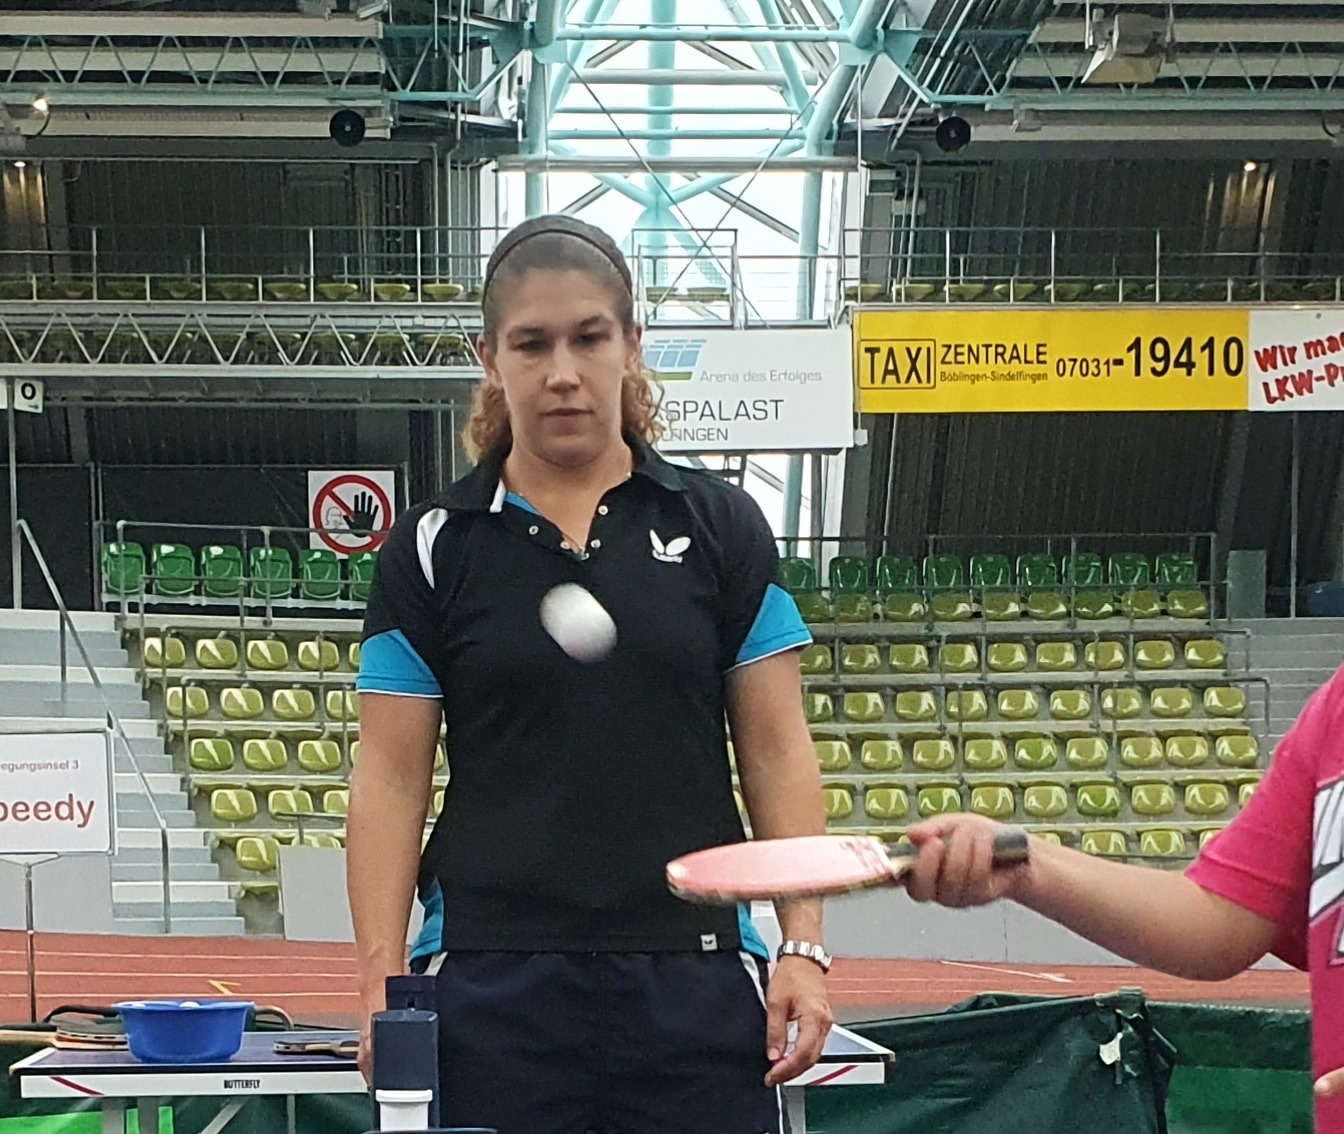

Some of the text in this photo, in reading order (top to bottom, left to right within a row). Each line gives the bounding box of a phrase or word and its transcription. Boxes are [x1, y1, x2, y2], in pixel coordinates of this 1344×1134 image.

[864, 336, 1245, 385] TAXI ZENTRALE 07031-19410
[1254, 344, 1297, 373] Wir
[699, 369, 823, 385] Arena des Erfolges
[940, 370, 1048, 385] Böblingen-Sindelfingen
[20, 382, 37, 400] O
[659, 399, 785, 422] SPALAST
[71, 759, 80, 770] 3
